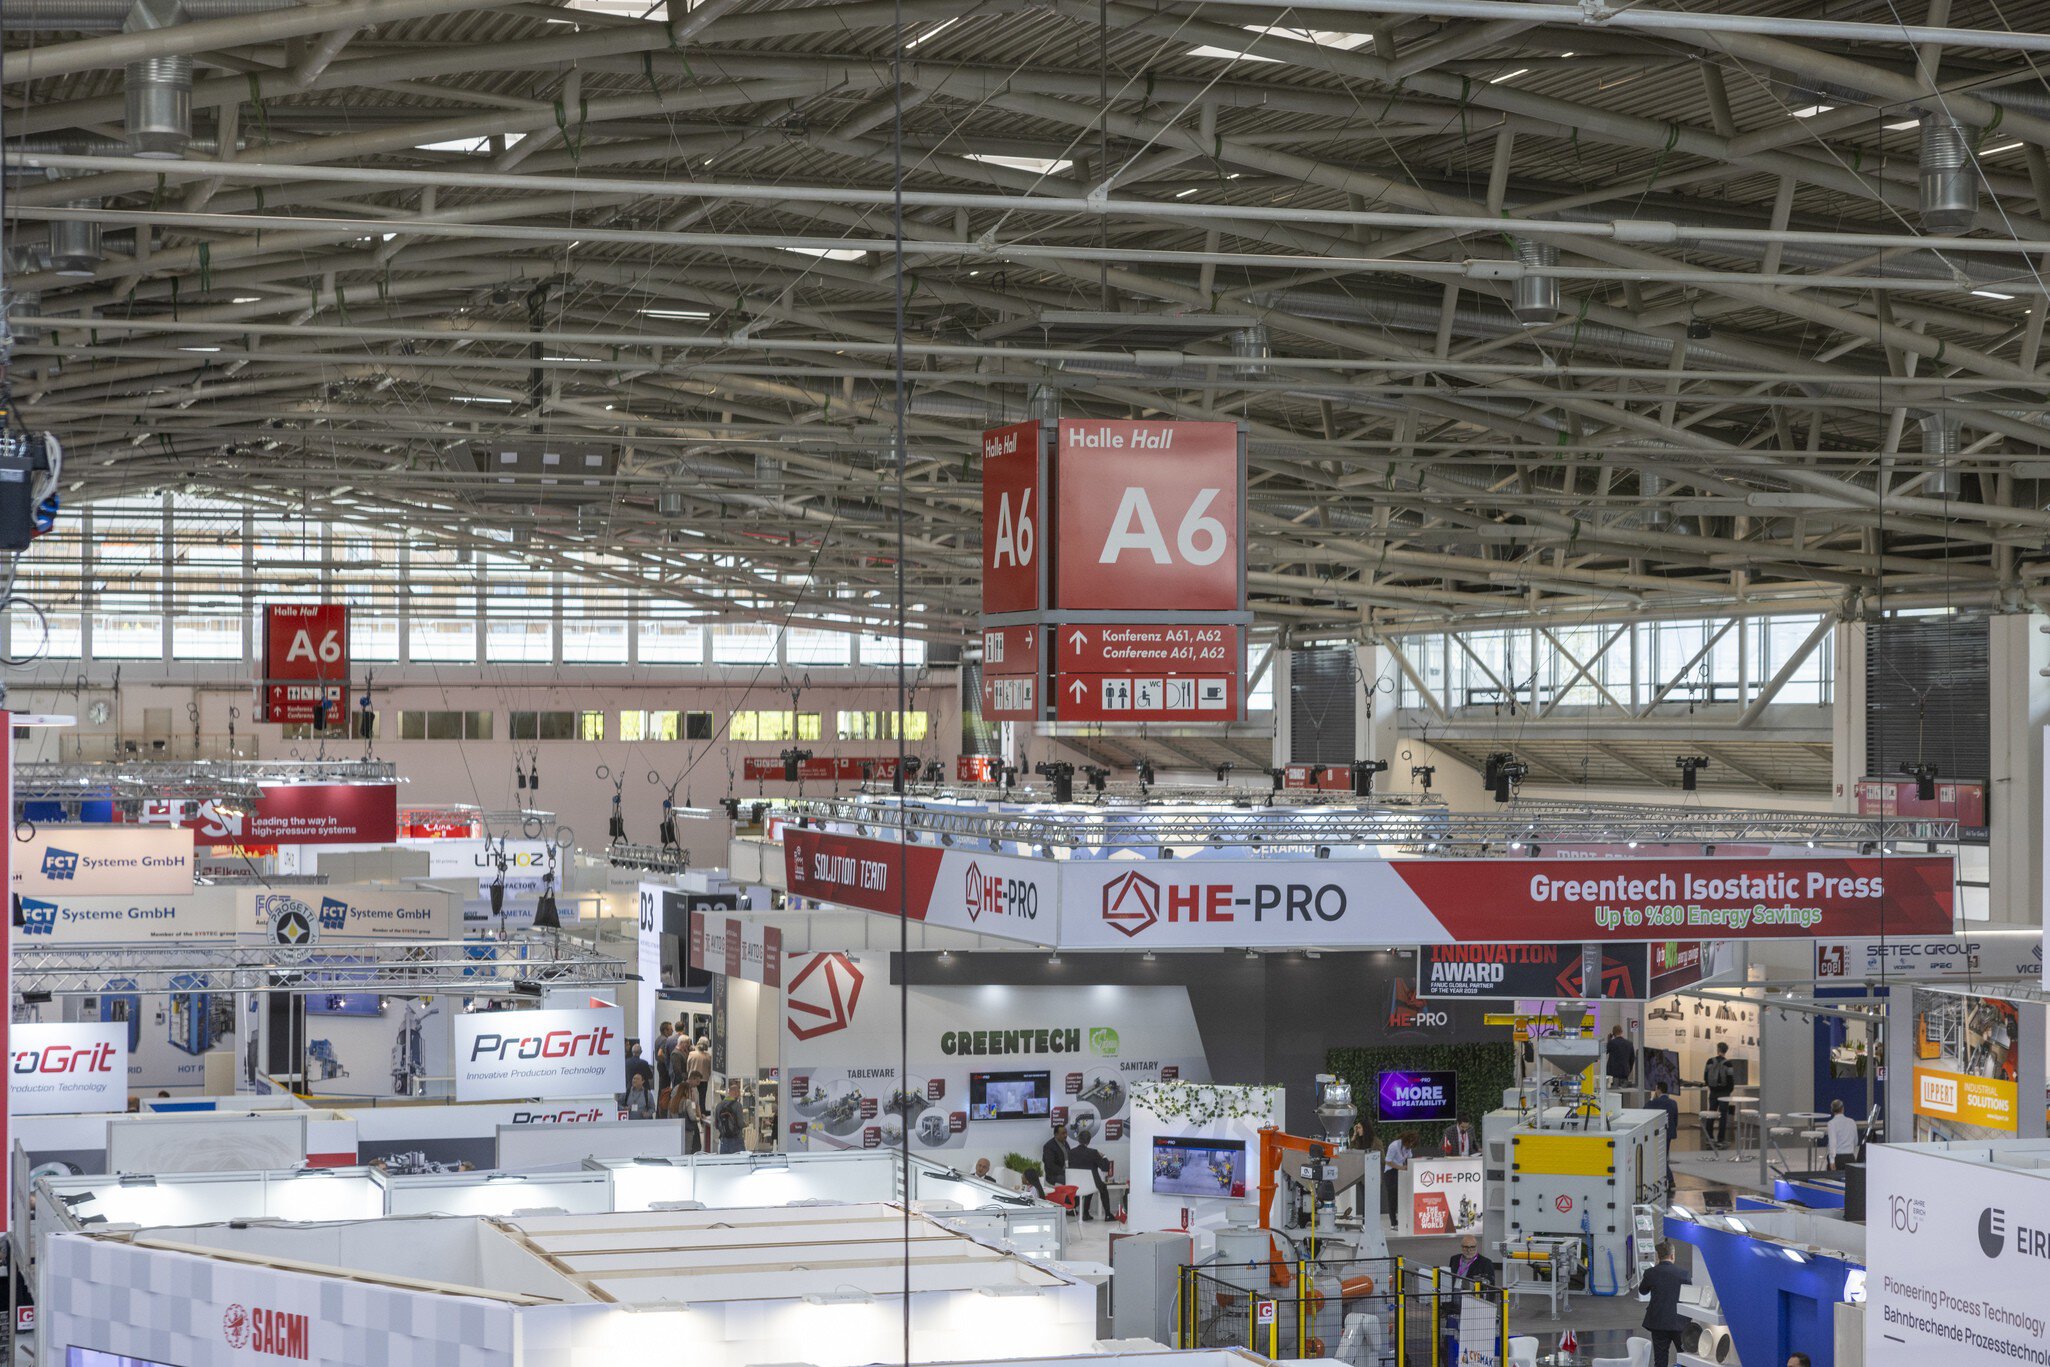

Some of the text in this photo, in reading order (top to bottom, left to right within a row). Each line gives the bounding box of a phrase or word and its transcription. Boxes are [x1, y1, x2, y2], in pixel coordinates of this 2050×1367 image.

[985, 432, 1018, 458] Halle Hall
[1069, 428, 1173, 449] Halle Hall
[993, 487, 1034, 569] A6
[1098, 487, 1227, 565] A6
[274, 606, 319, 616] Halle Hall
[1102, 630, 1222, 644] Konferenz A61, A62
[286, 629, 341, 663] A6
[1102, 646, 1225, 660] Conference A61, A62
[251, 816, 337, 827] Leading the way in
[251, 826, 357, 837] high-pressure systems
[46, 856, 185, 870] FCT Systeme GmbH
[474, 852, 544, 867] LITHOZ
[814, 852, 888, 892] SOLUTION TEAM
[1530, 871, 1885, 901] Greentech Isostatic Press
[984, 876, 1038, 921] HE-PRO
[1168, 883, 1347, 922] HE-PRO
[23, 906, 176, 923] FCT Systeme GmbH
[271, 901, 315, 923] PROGETTI
[322, 906, 431, 921] FCT Systeme GmbH
[640, 891, 654, 933] D3
[1595, 905, 1822, 930] Up to %80 Energy Savings
[1430, 944, 1558, 964] INNOVATION
[1866, 943, 1981, 957] SETEC GROUP
[1431, 962, 1504, 983] AWARD
[1390, 1011, 1448, 1027] HE-PRO
[471, 1026, 615, 1062] ProGrit
[941, 1027, 1081, 1056] GREENTECH
[178, 1064, 196, 1074] HOT
[466, 1065, 606, 1080] Innovative Production Technology
[847, 1068, 895, 1079] TABLEWARE
[1120, 1061, 1159, 1071] SANITARY
[58, 1082, 107, 1093] Technology
[1396, 1086, 1443, 1100] MORE
[1924, 1082, 1954, 1103] LIPPERT
[1964, 1083, 1998, 1096] INDUSTRIAL
[1392, 1098, 1447, 1107] REPEATABILITY
[1967, 1094, 2009, 1112] SOLUTIONS
[1436, 1172, 1481, 1184] HE-PRO
[1418, 1211, 1446, 1219] FASTEST
[1421, 1221, 1444, 1229] WORLD
[1884, 1275, 2046, 1338] Pioneering Process Technology
[1884, 1304, 1963, 1342] Bahnbrechende
[252, 1307, 309, 1361] SACMI
